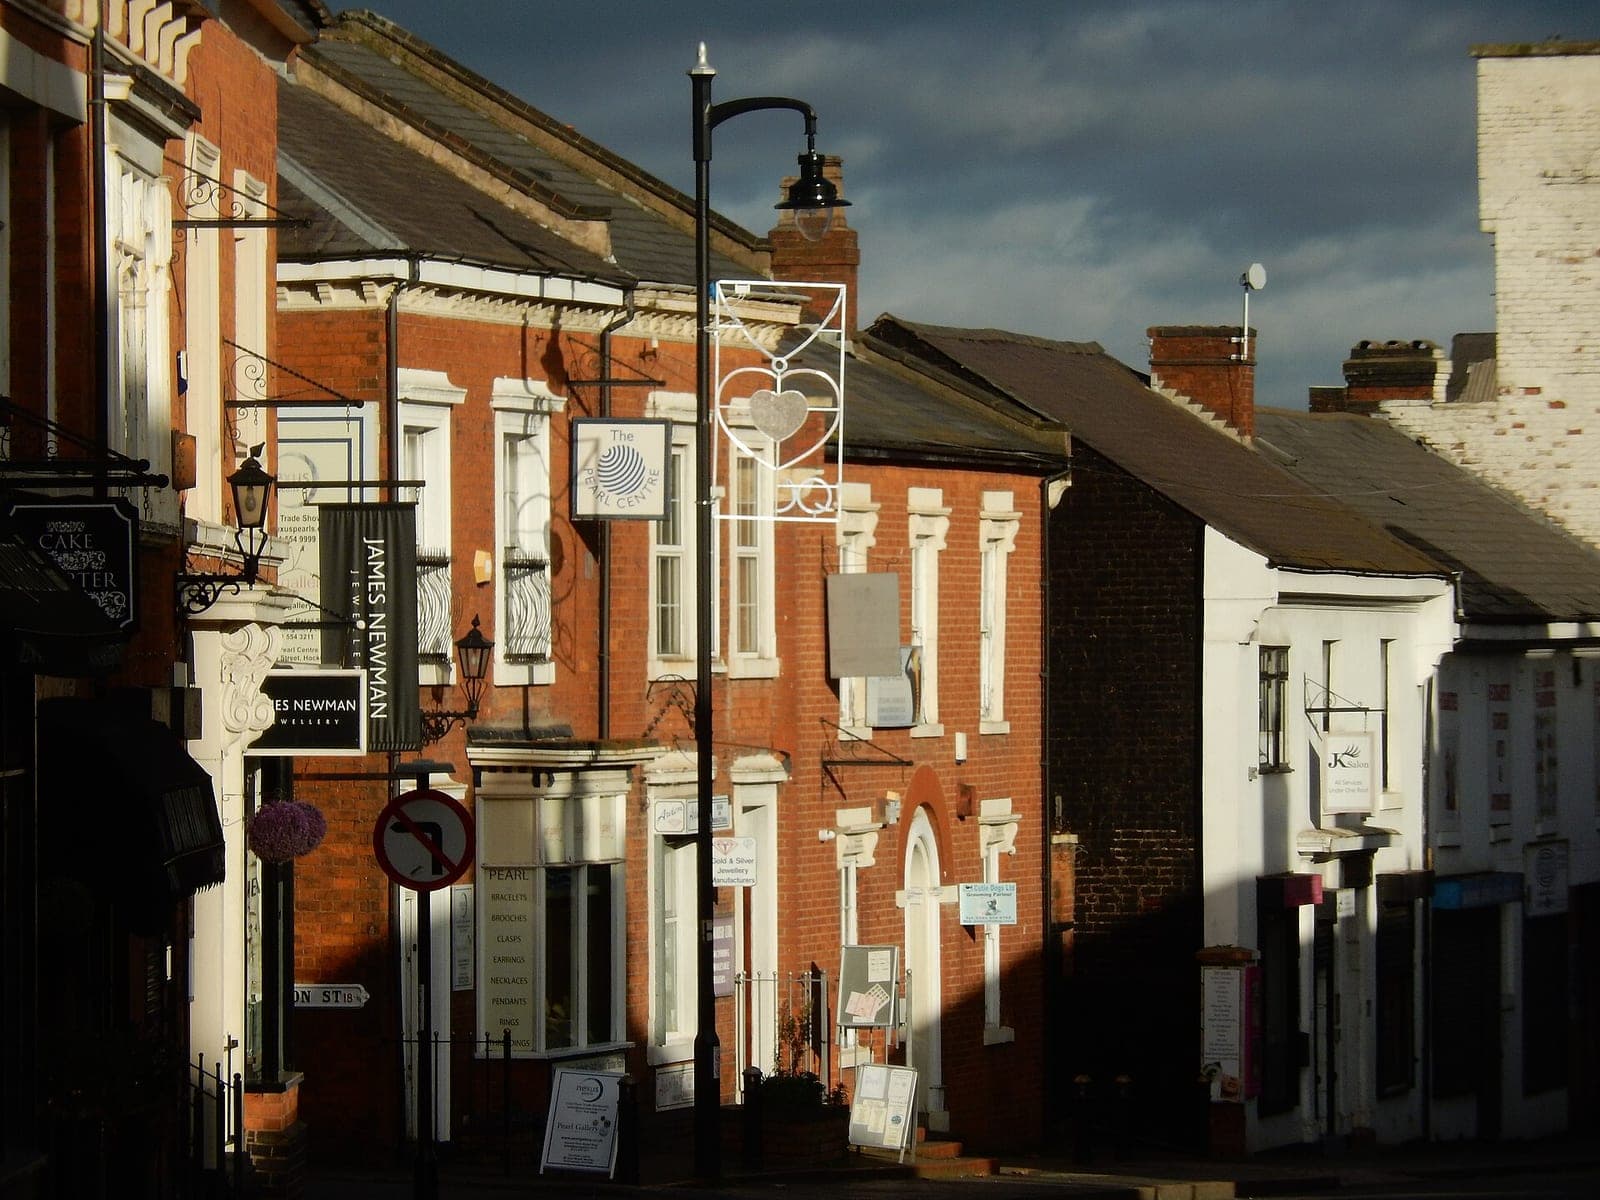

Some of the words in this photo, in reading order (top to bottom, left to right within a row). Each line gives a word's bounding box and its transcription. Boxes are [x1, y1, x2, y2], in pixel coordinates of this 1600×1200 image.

[610, 429, 634, 442] The
[584, 468, 610, 506] PEARL
[616, 468, 660, 509] CENTRE
[280, 514, 301, 522] Trade
[303, 514, 320, 522] Sho
[39, 533, 97, 550] CAKE
[363, 537, 386, 605] JAMES
[368, 612, 388, 719] NEWMAN
[293, 699, 356, 711] NEWMAN
[735, 857, 755, 865] Silver
[489, 869, 529, 881] PEARL
[717, 867, 749, 876] Jewellery
[491, 893, 527, 902] BRACELETS
[491, 914, 527, 922] BROOCHES
[497, 935, 522, 943] CLASPS
[493, 956, 525, 964] EARRINGS
[490, 976, 528, 985] NECKLACES
[322, 990, 342, 1003] ST
[492, 997, 527, 1006] PENDANTS
[499, 1018, 519, 1026] RINGS
